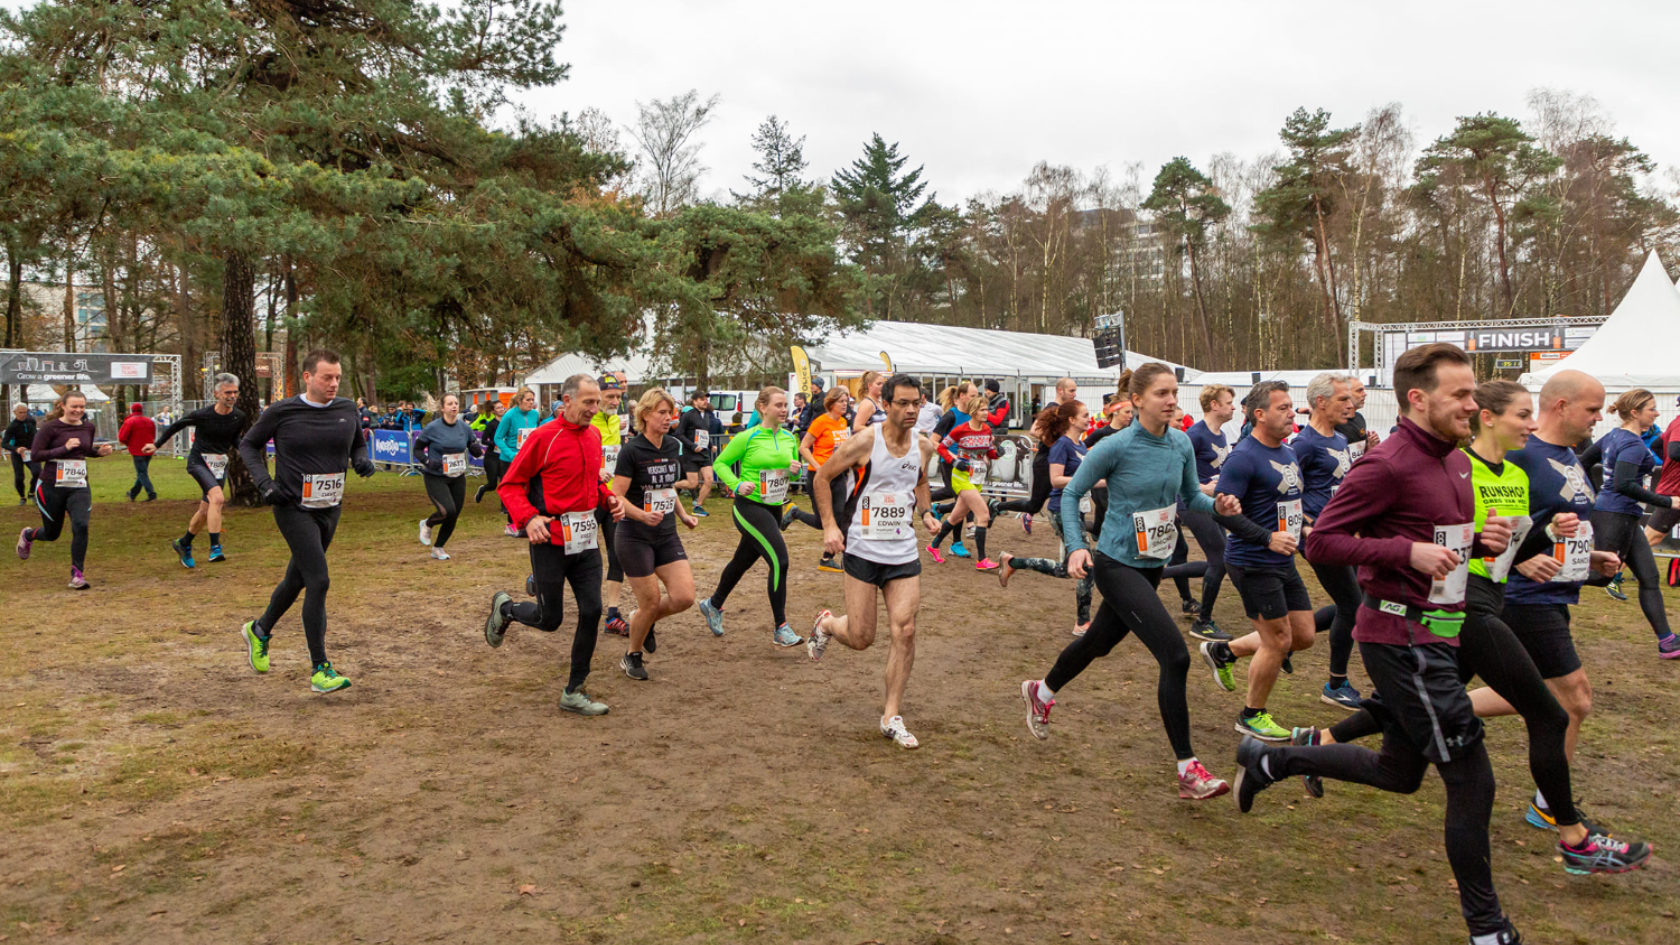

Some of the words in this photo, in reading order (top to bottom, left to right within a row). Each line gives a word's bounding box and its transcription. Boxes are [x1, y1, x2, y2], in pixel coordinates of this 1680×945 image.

[1478, 331, 1550, 347] FINISH
[316, 479, 342, 490] 7516
[768, 477, 789, 488] 7807
[871, 507, 906, 518] 7889
[572, 519, 597, 532] 7595
